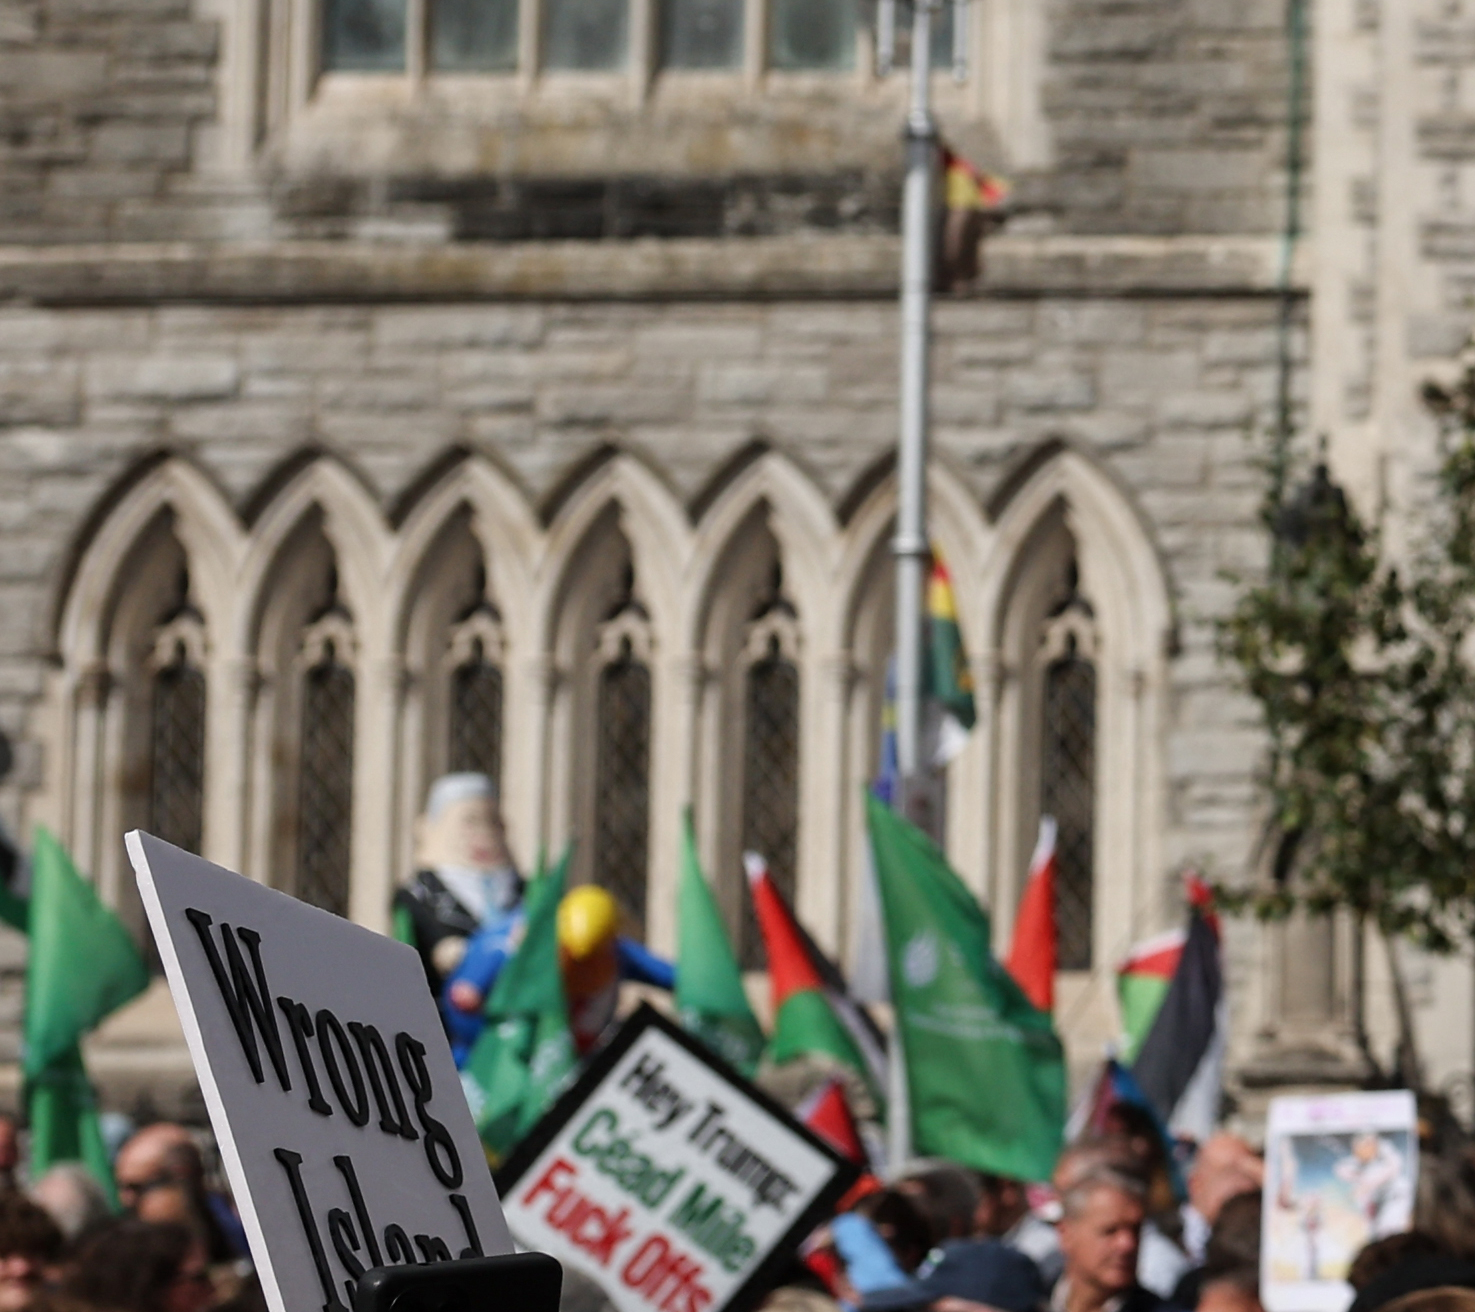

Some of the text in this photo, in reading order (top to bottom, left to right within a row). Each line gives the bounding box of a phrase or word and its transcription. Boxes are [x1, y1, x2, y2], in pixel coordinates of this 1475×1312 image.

[185, 907, 463, 1189] Wrong
[618, 1052, 695, 1131] Hey
[521, 1156, 634, 1269] Fuck
